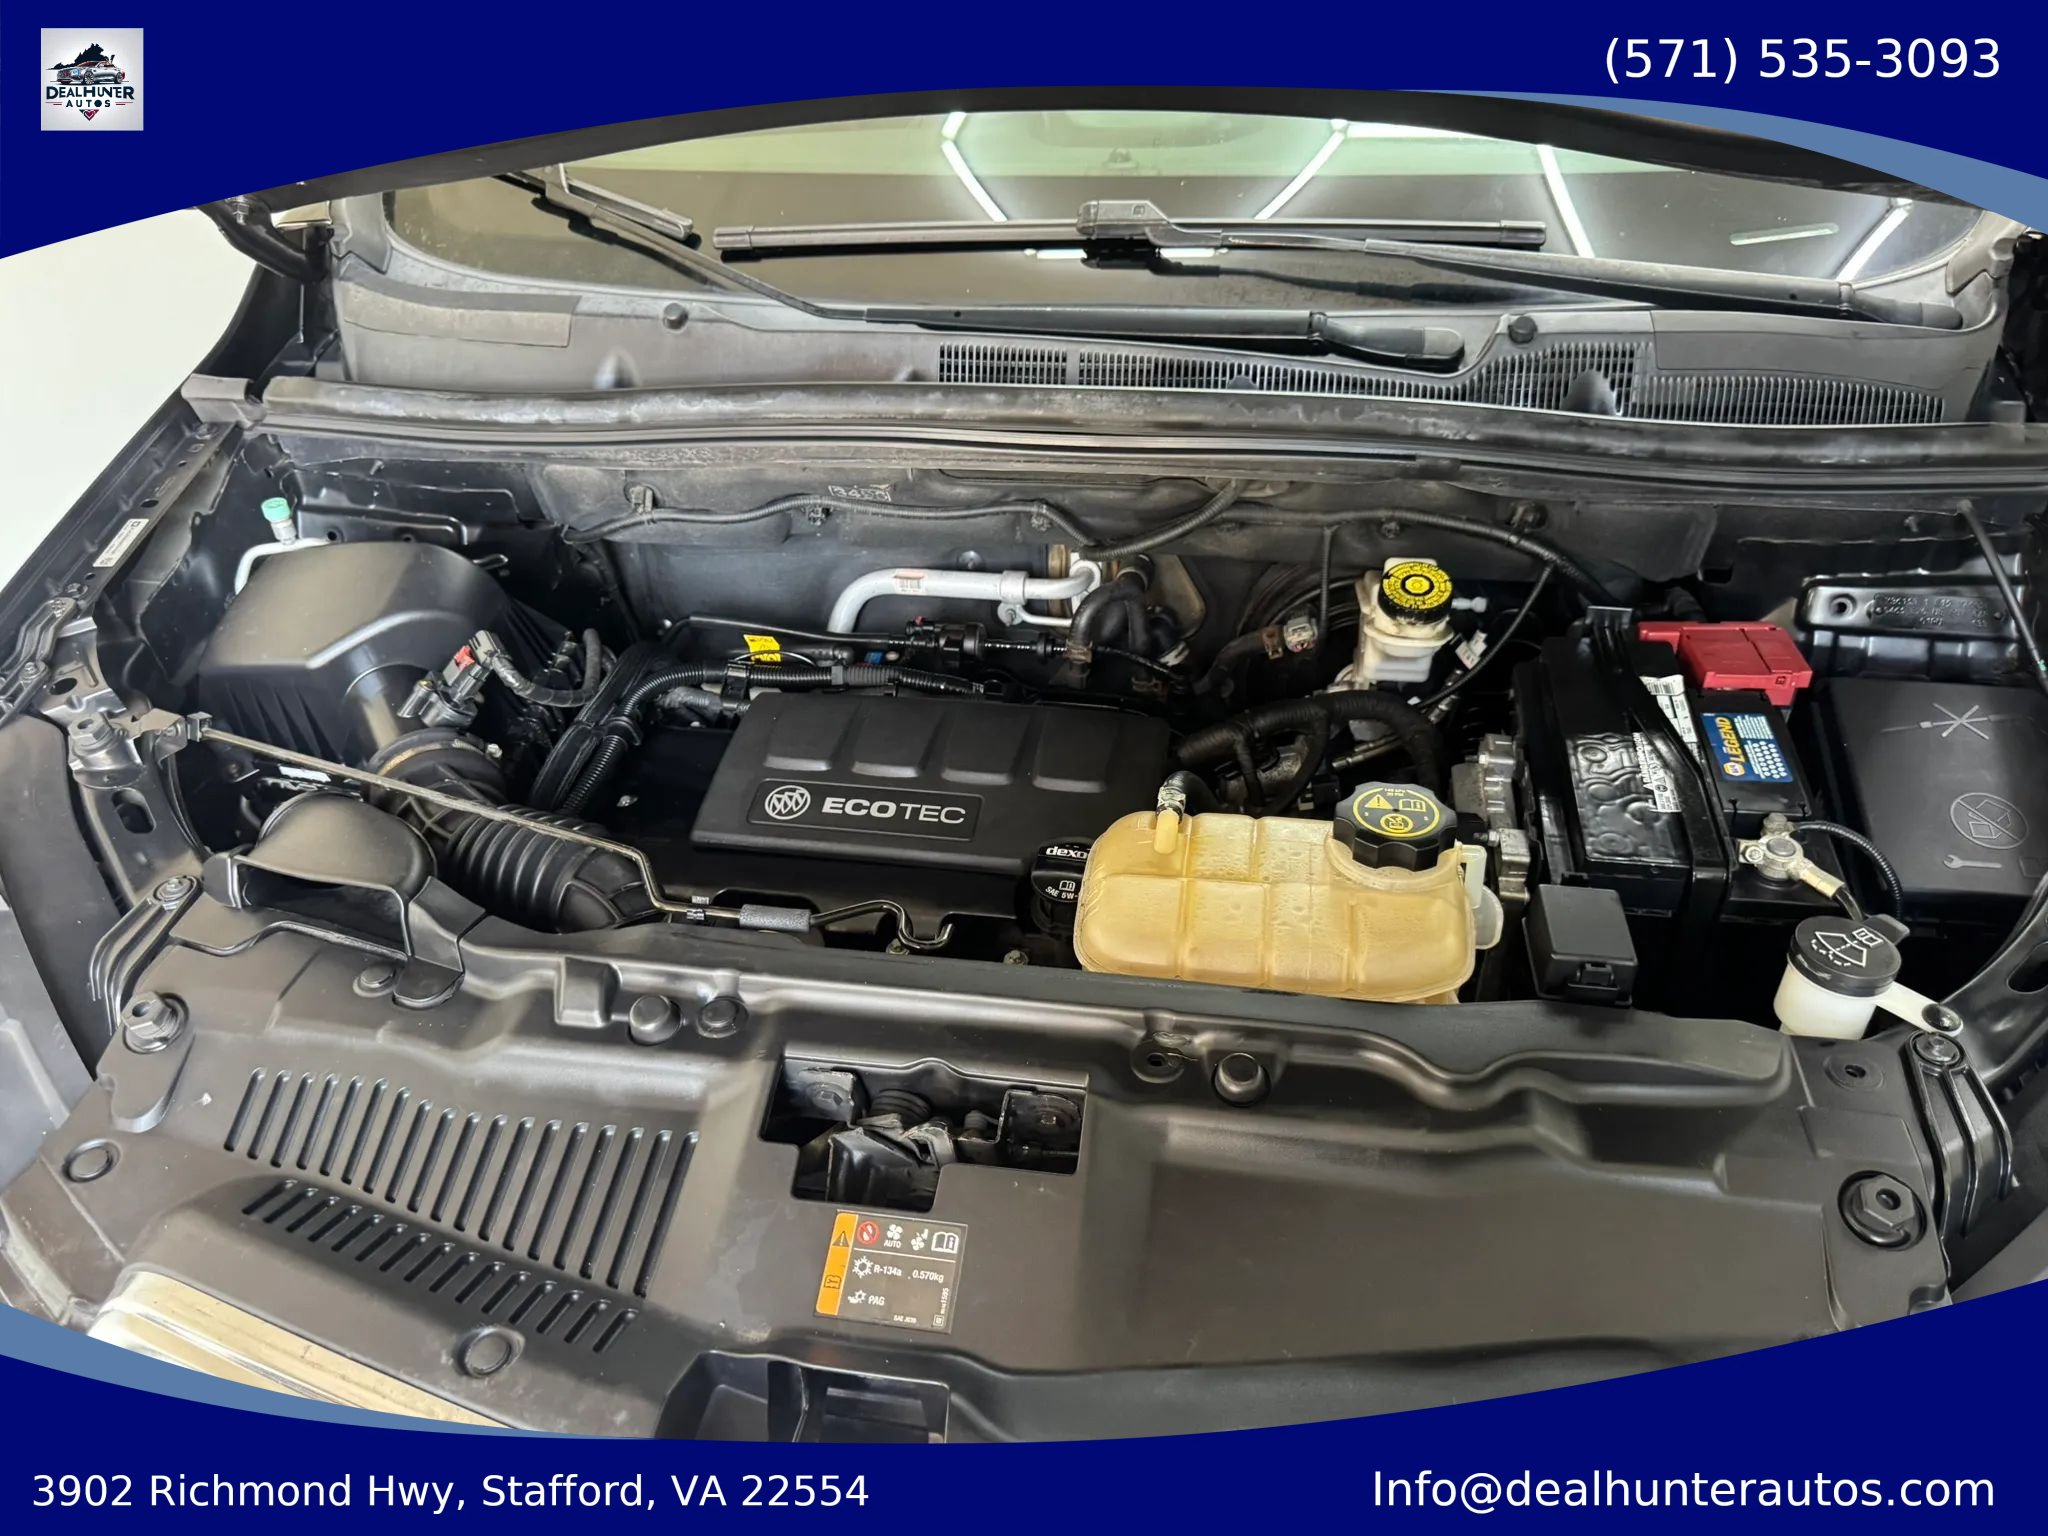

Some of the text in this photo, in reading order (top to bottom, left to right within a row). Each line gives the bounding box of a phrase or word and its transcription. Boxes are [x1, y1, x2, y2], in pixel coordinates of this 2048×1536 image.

[1715, 716, 1747, 764] LEGEND
[821, 796, 967, 825] ECOTEC
[1045, 846, 1088, 859] dexo
[1045, 886, 1081, 900] SAE 5W-
[883, 1239, 902, 1249] AUTO
[873, 1264, 945, 1284] R-134a 0.570kg
[868, 1295, 886, 1306] PAG
